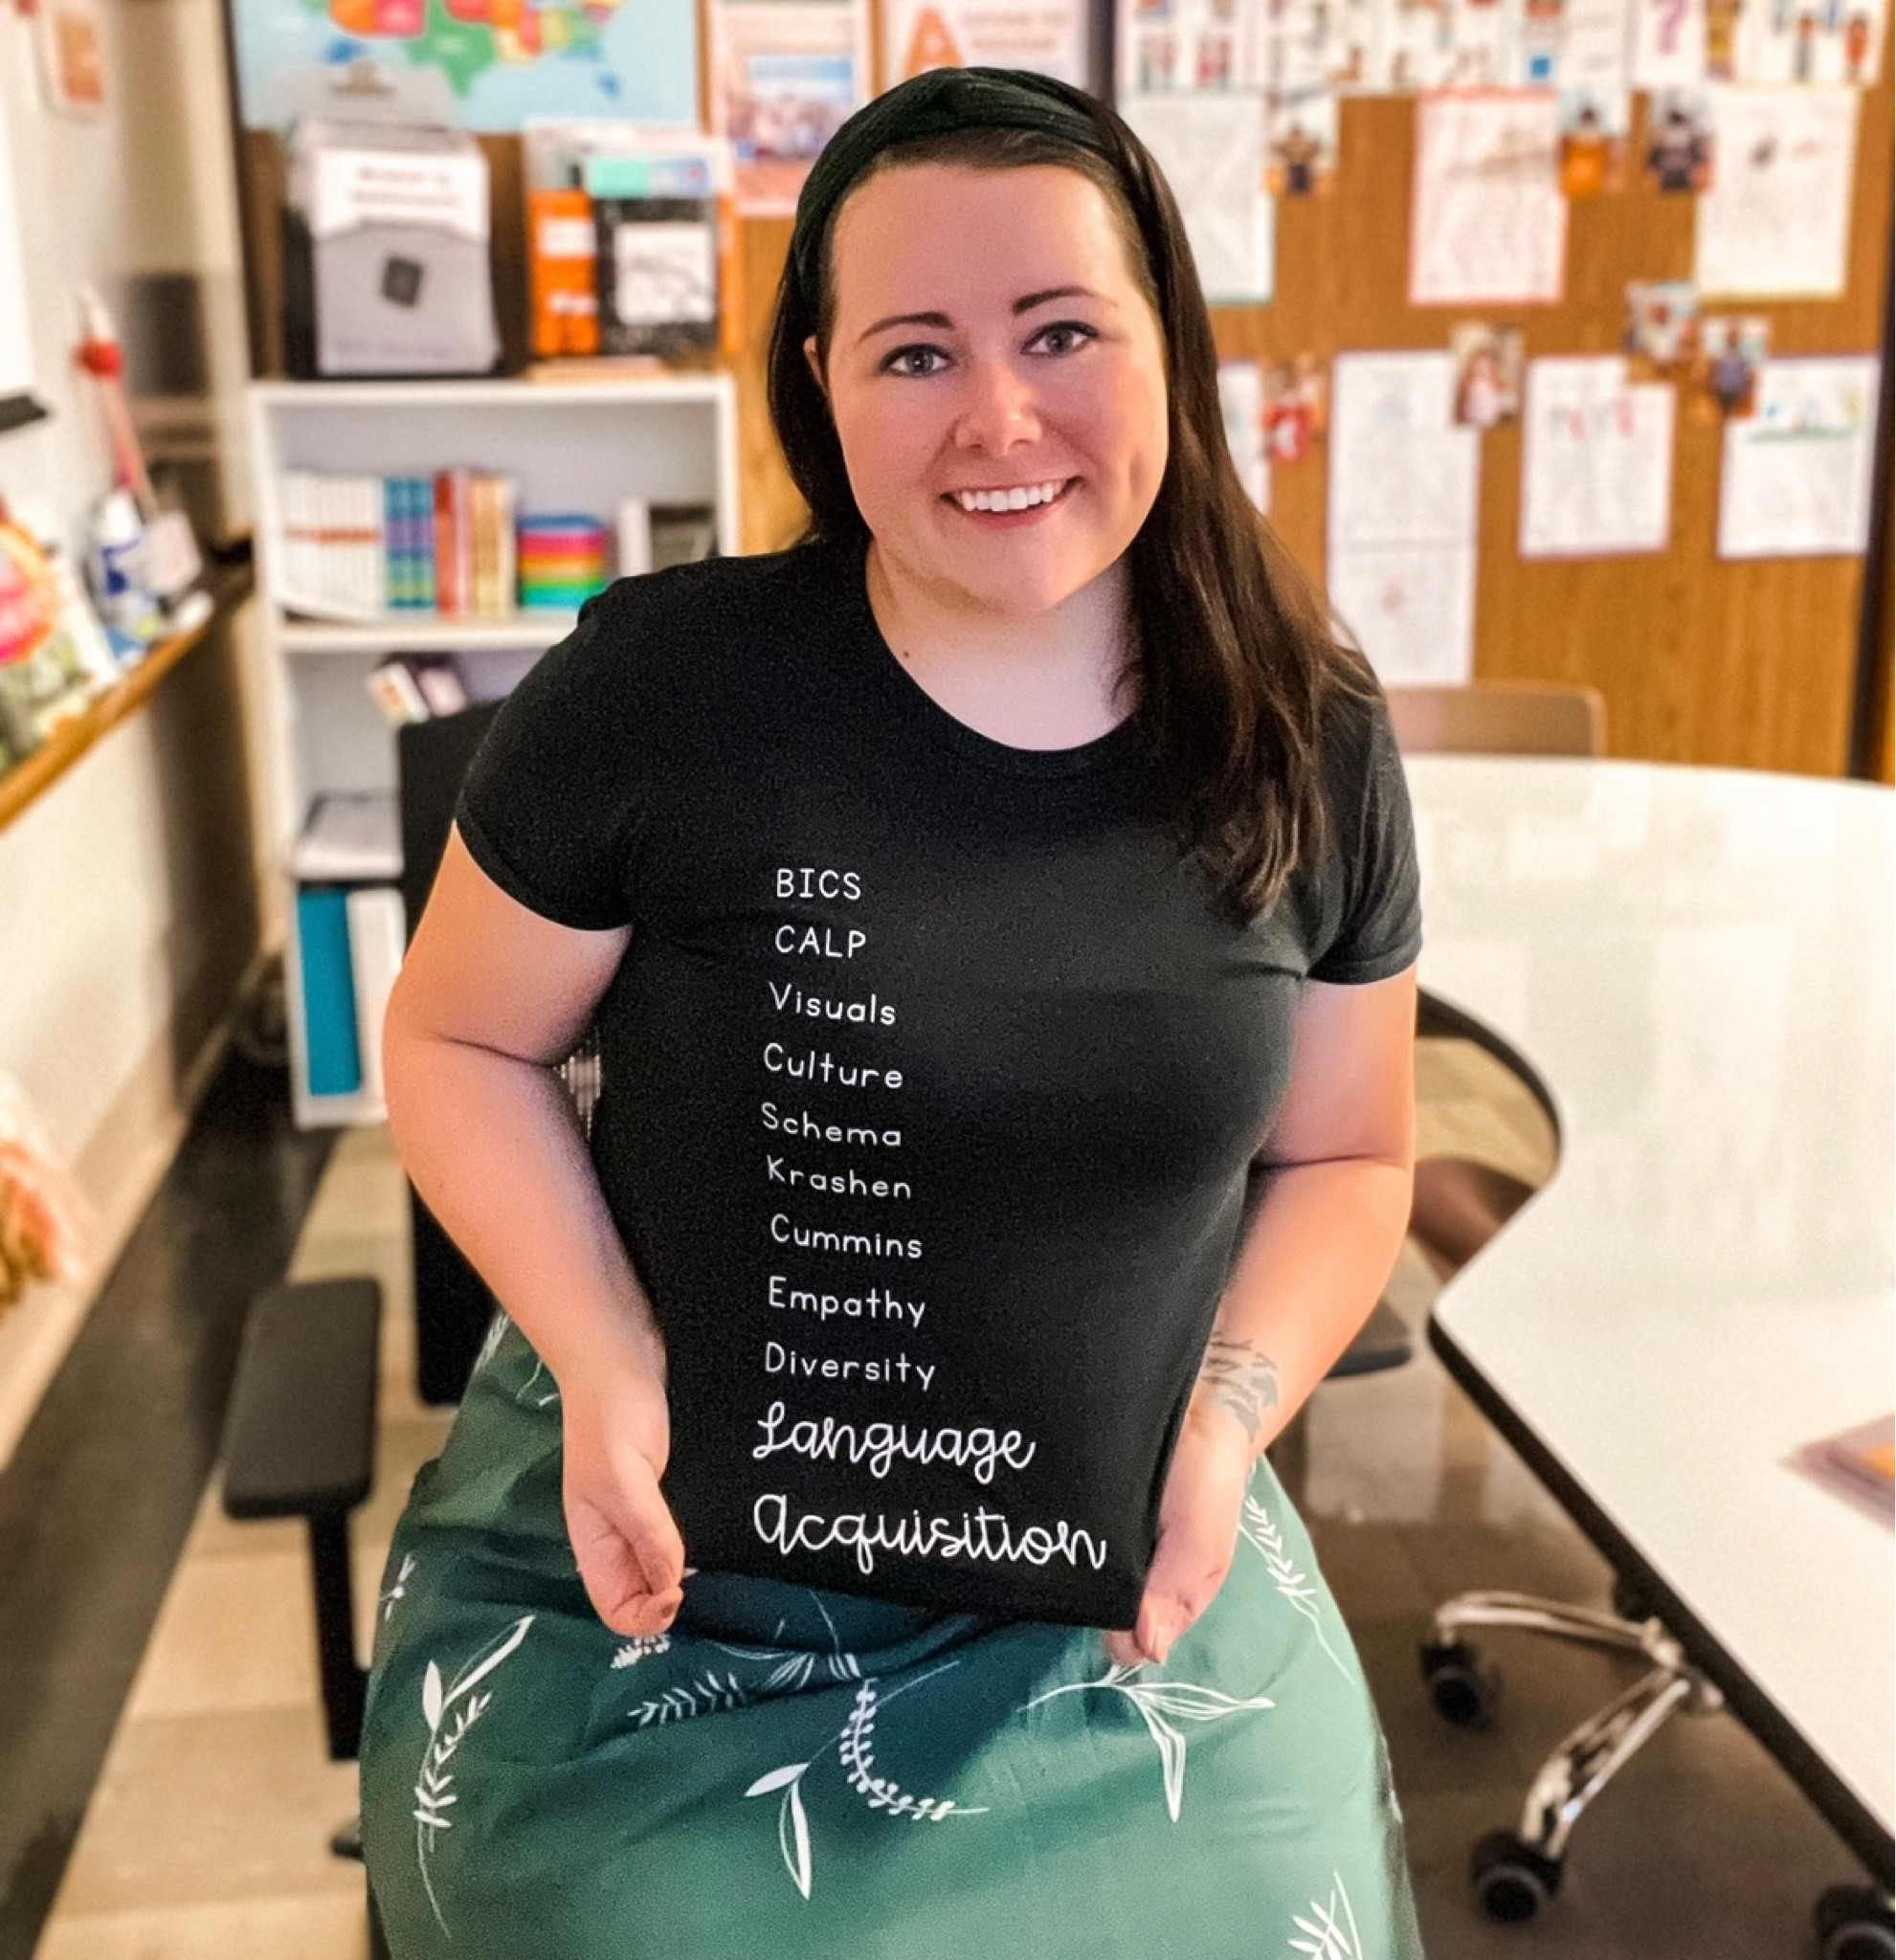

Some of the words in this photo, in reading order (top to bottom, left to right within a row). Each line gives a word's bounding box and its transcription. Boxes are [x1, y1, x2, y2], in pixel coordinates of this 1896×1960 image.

[776, 867, 861, 901] BICS
[774, 924, 867, 959] CALP
[769, 981, 896, 1026] Visuals
[764, 1042, 903, 1089] Culture
[761, 1102, 902, 1147] Schema
[767, 1154, 911, 1198] Krashen
[770, 1213, 923, 1258] Cummins
[769, 1275, 926, 1328] Empathy
[765, 1341, 936, 1392] Diversity
[752, 1401, 1037, 1484] Language
